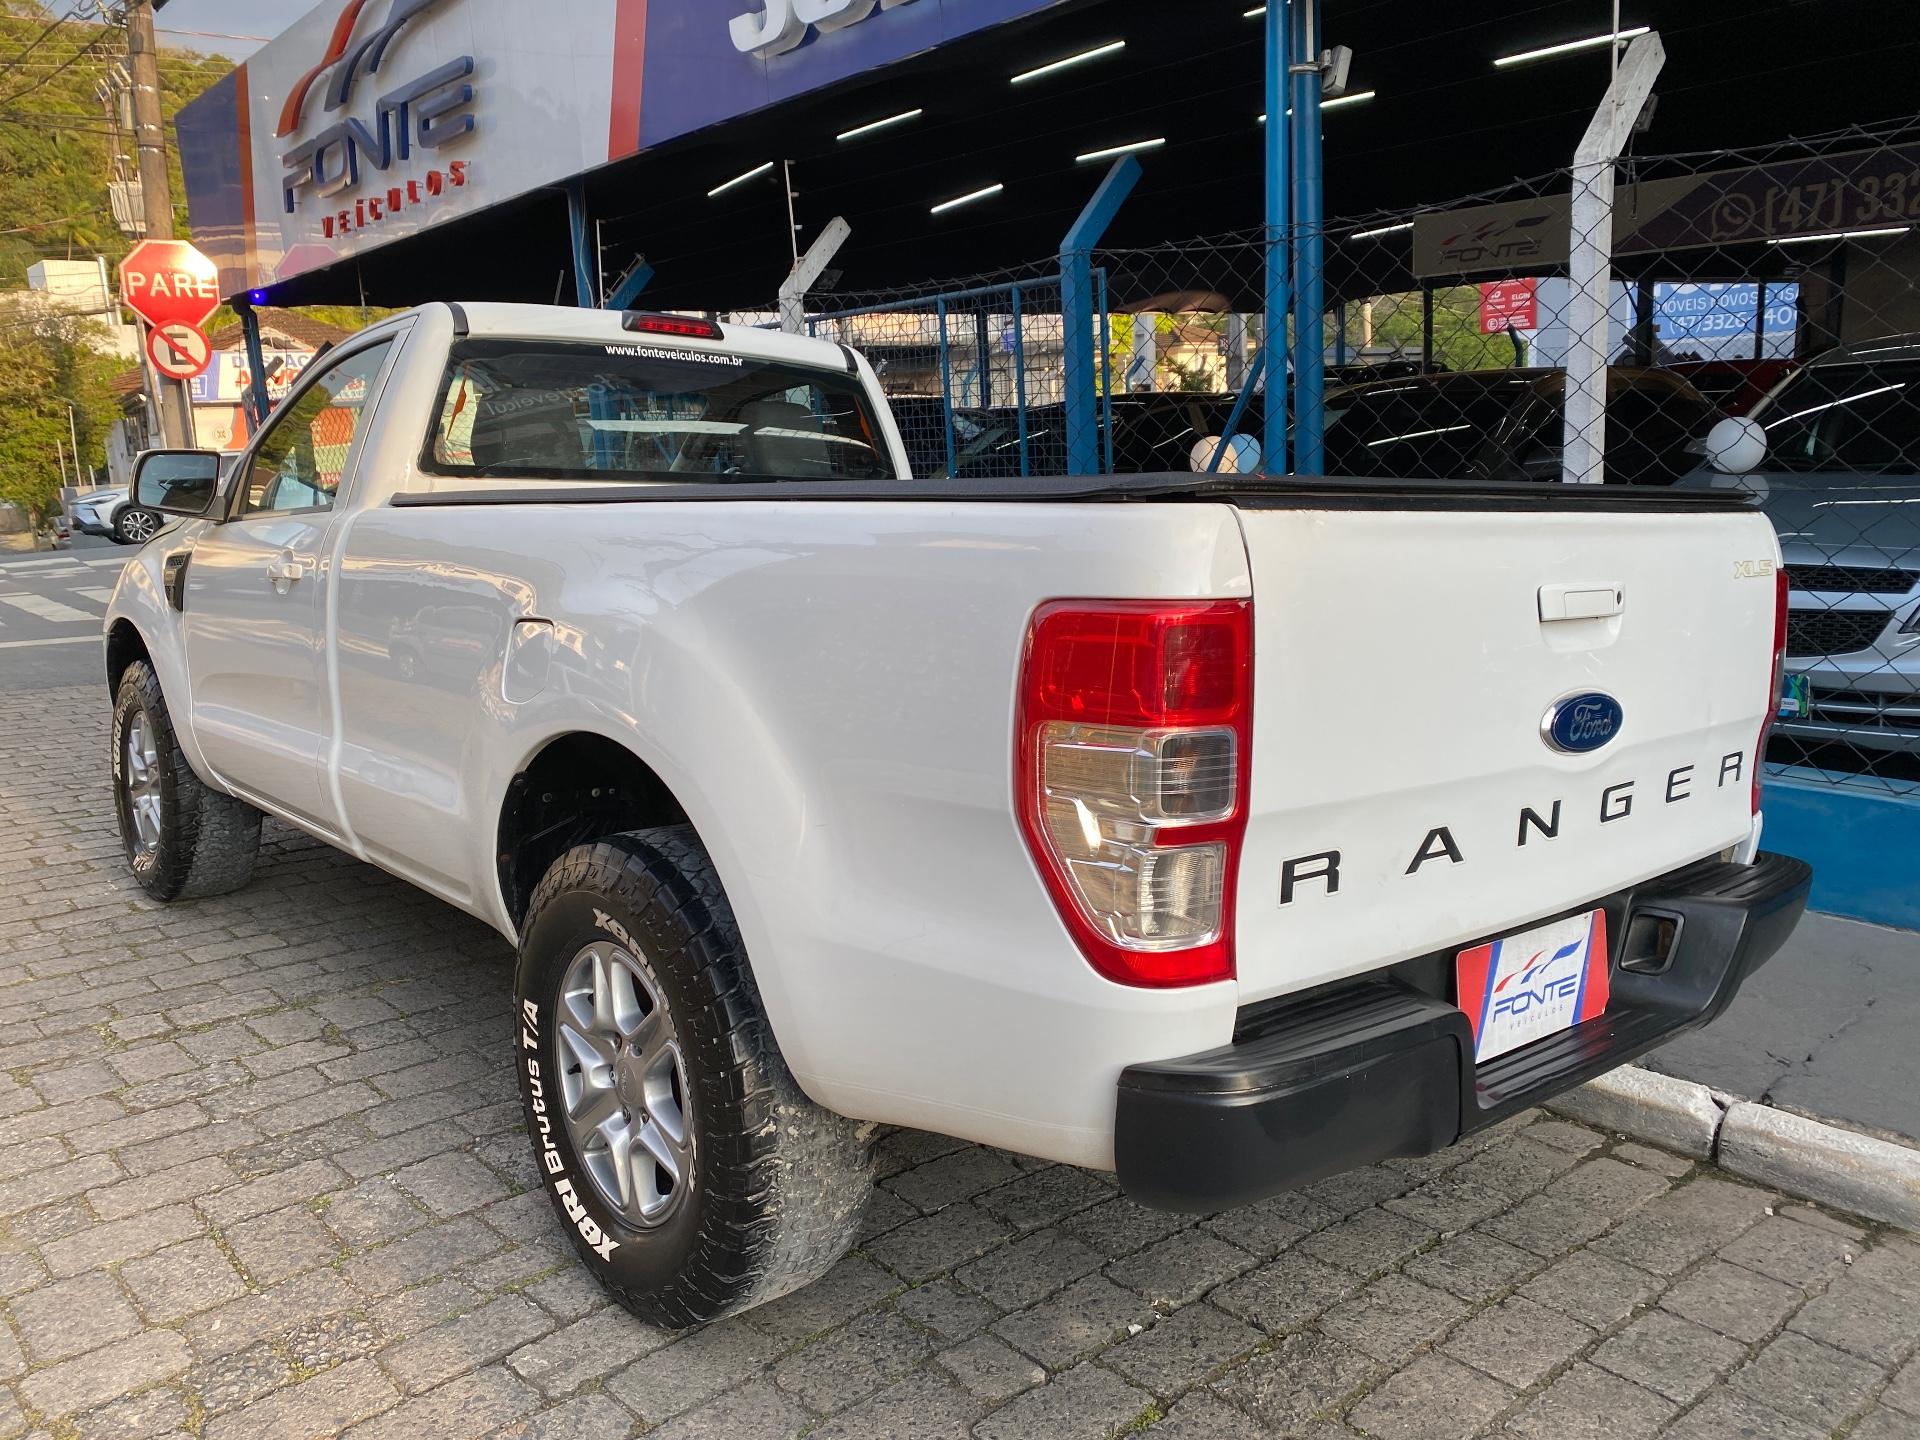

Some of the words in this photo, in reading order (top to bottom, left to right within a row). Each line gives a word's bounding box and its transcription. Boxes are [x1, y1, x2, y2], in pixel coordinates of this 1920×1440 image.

[282, 55, 474, 213] FONTE
[1438, 239, 1543, 265] FONTE
[127, 271, 215, 298] PARE
[604, 345, 744, 367] www.fonteveiculos.com.br
[1734, 559, 1774, 579] XLS
[1569, 703, 1613, 742] Ford
[1280, 751, 1744, 905] RANGER
[522, 998, 539, 1050] T/A
[1492, 973, 1578, 1024] FONTE
[527, 1058, 565, 1175] Brutus
[554, 1178, 621, 1262] XBRI
